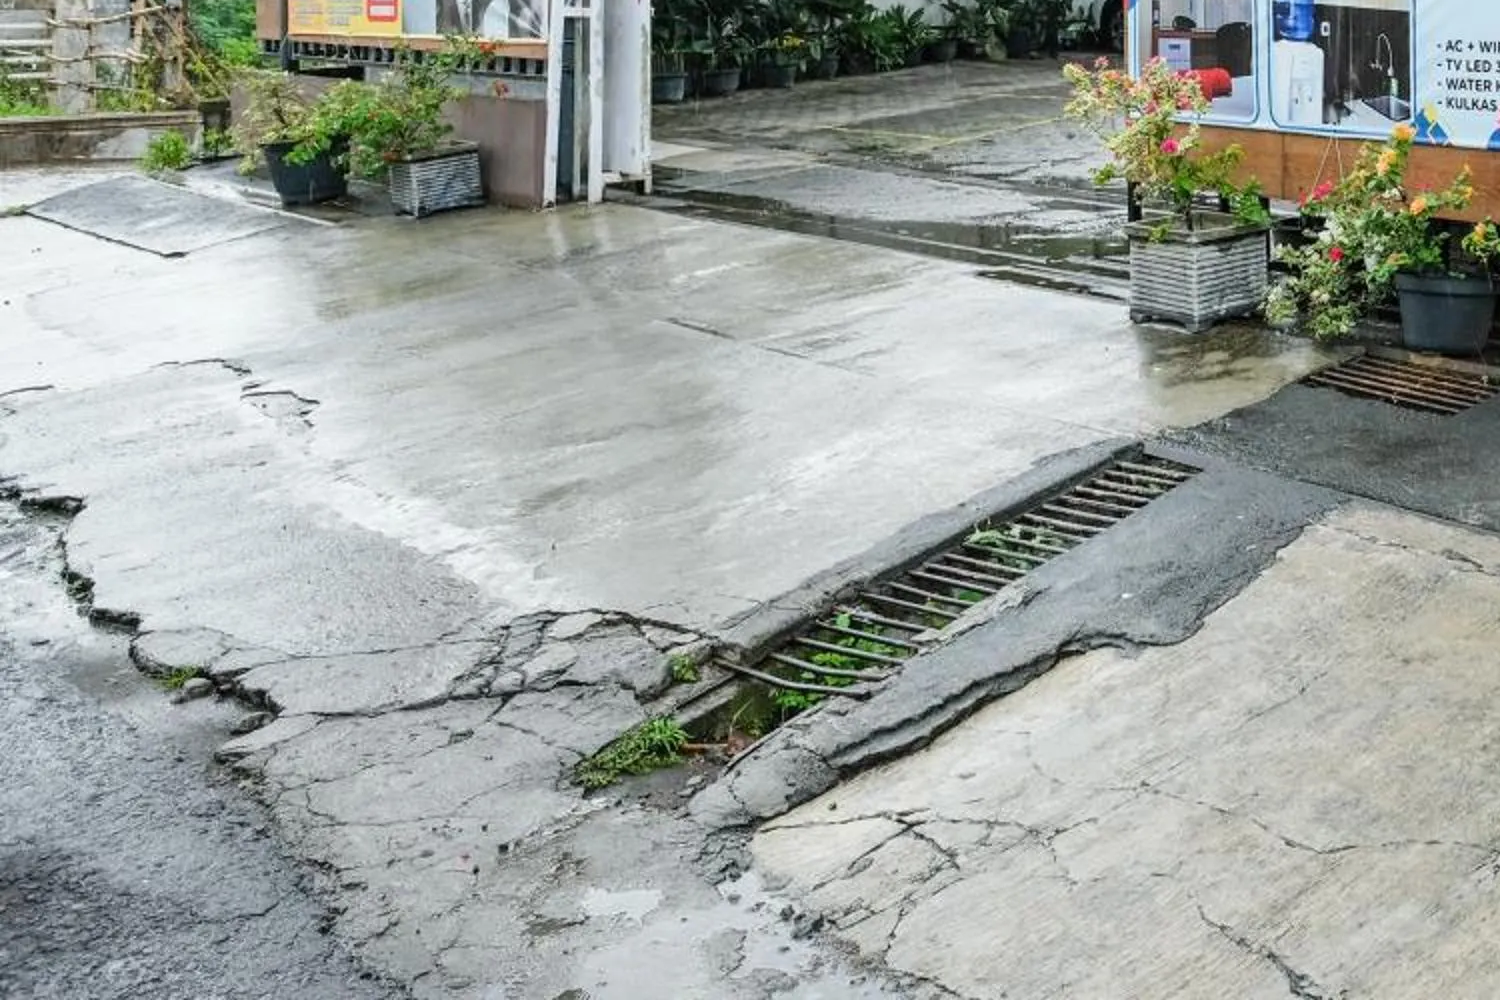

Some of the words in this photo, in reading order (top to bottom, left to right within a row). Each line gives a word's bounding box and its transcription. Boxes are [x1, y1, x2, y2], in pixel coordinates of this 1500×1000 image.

[1445, 40, 1463, 53] AC
[1445, 59, 1463, 71] TV
[1466, 60, 1493, 73] LED
[1445, 78, 1492, 93] WATER
[1445, 97, 1498, 112] KULKAS
